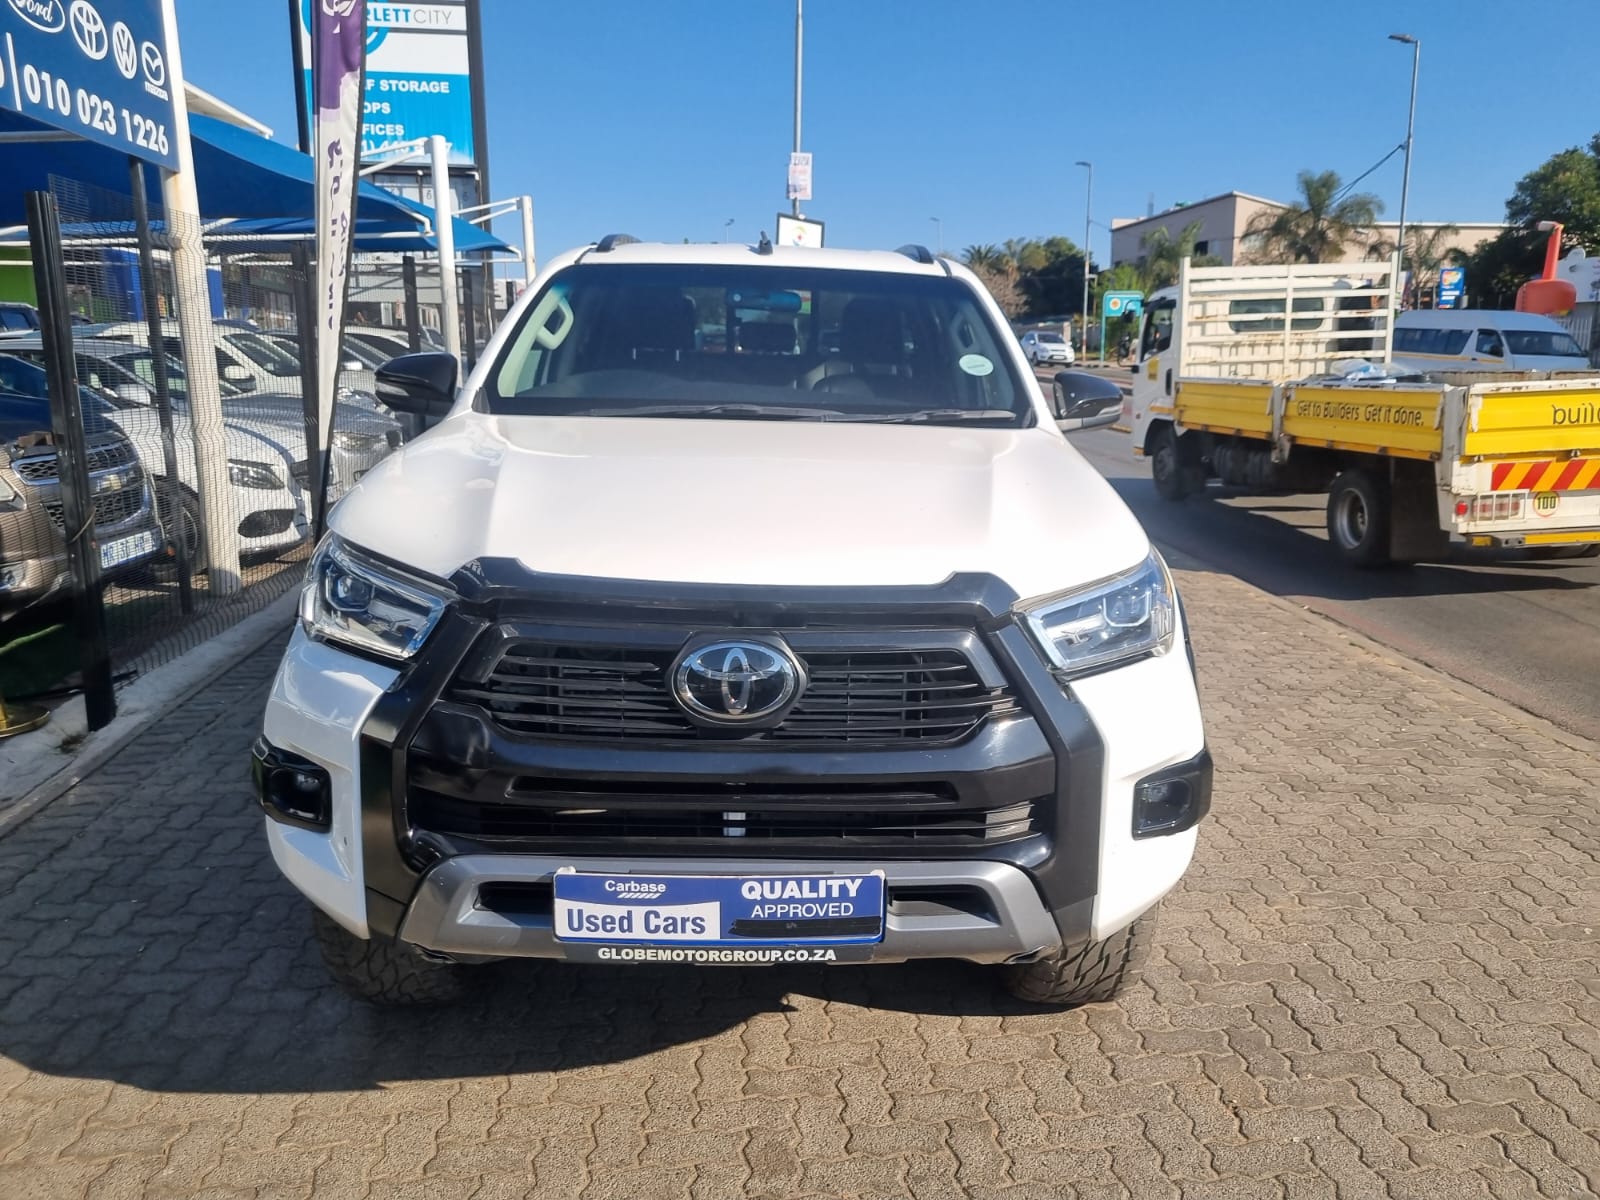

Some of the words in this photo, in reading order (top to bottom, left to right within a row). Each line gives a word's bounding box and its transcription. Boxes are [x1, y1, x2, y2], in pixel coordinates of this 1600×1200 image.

[379, 79, 450, 93] STORAGE
[23, 64, 71, 116] 010
[77, 88, 117, 135] 023
[122, 108, 169, 156] 1226
[1298, 400, 1311, 416] Get
[1312, 401, 1322, 416] to
[1364, 404, 1382, 422] Get
[1383, 406, 1391, 423] it
[1393, 406, 1425, 426] done.
[1537, 495, 1557, 510] 100
[604, 880, 667, 893] Carbase
[741, 878, 864, 901] QUALITY
[751, 902, 854, 918] APPROVED
[567, 908, 634, 934] Used
[644, 910, 706, 935] Cars
[597, 947, 837, 963] GLOBEMOTORGROUP.CO.ZA
